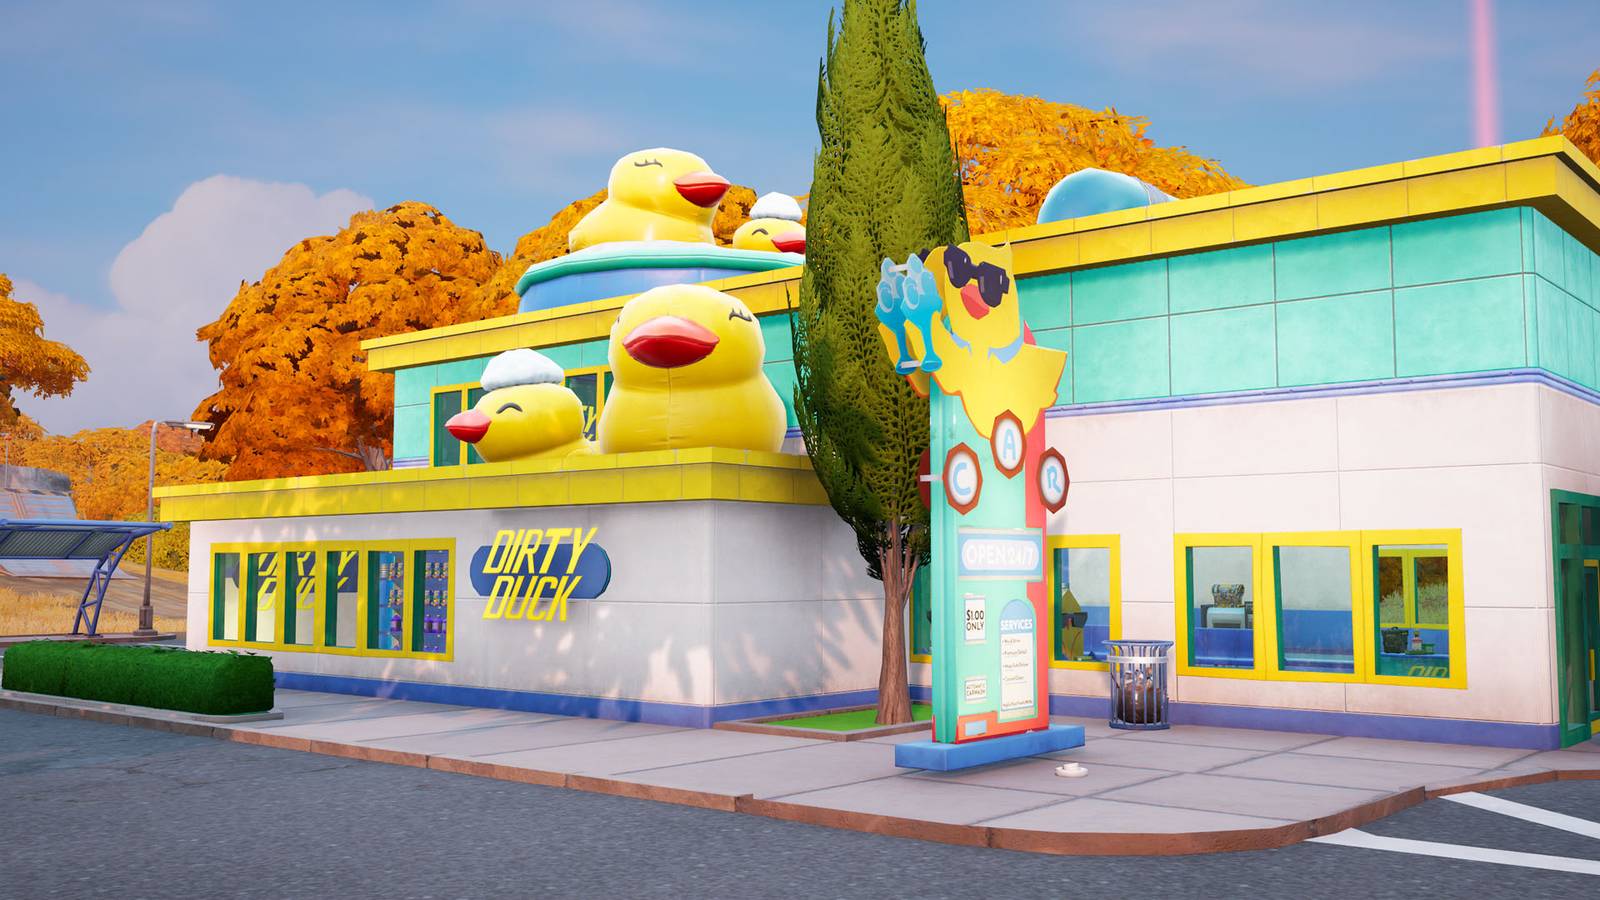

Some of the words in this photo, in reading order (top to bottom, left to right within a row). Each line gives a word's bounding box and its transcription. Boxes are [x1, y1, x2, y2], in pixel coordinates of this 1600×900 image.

[953, 462, 971, 495] C
[1002, 428, 1017, 461] A
[1046, 465, 1062, 494] R
[482, 527, 597, 575] DIRTY
[966, 544, 1006, 565] OPEN
[482, 575, 582, 622] DUCK
[966, 609, 985, 621] $1.00
[1000, 618, 1033, 631] SERVICES
[966, 621, 985, 631] ONLY
